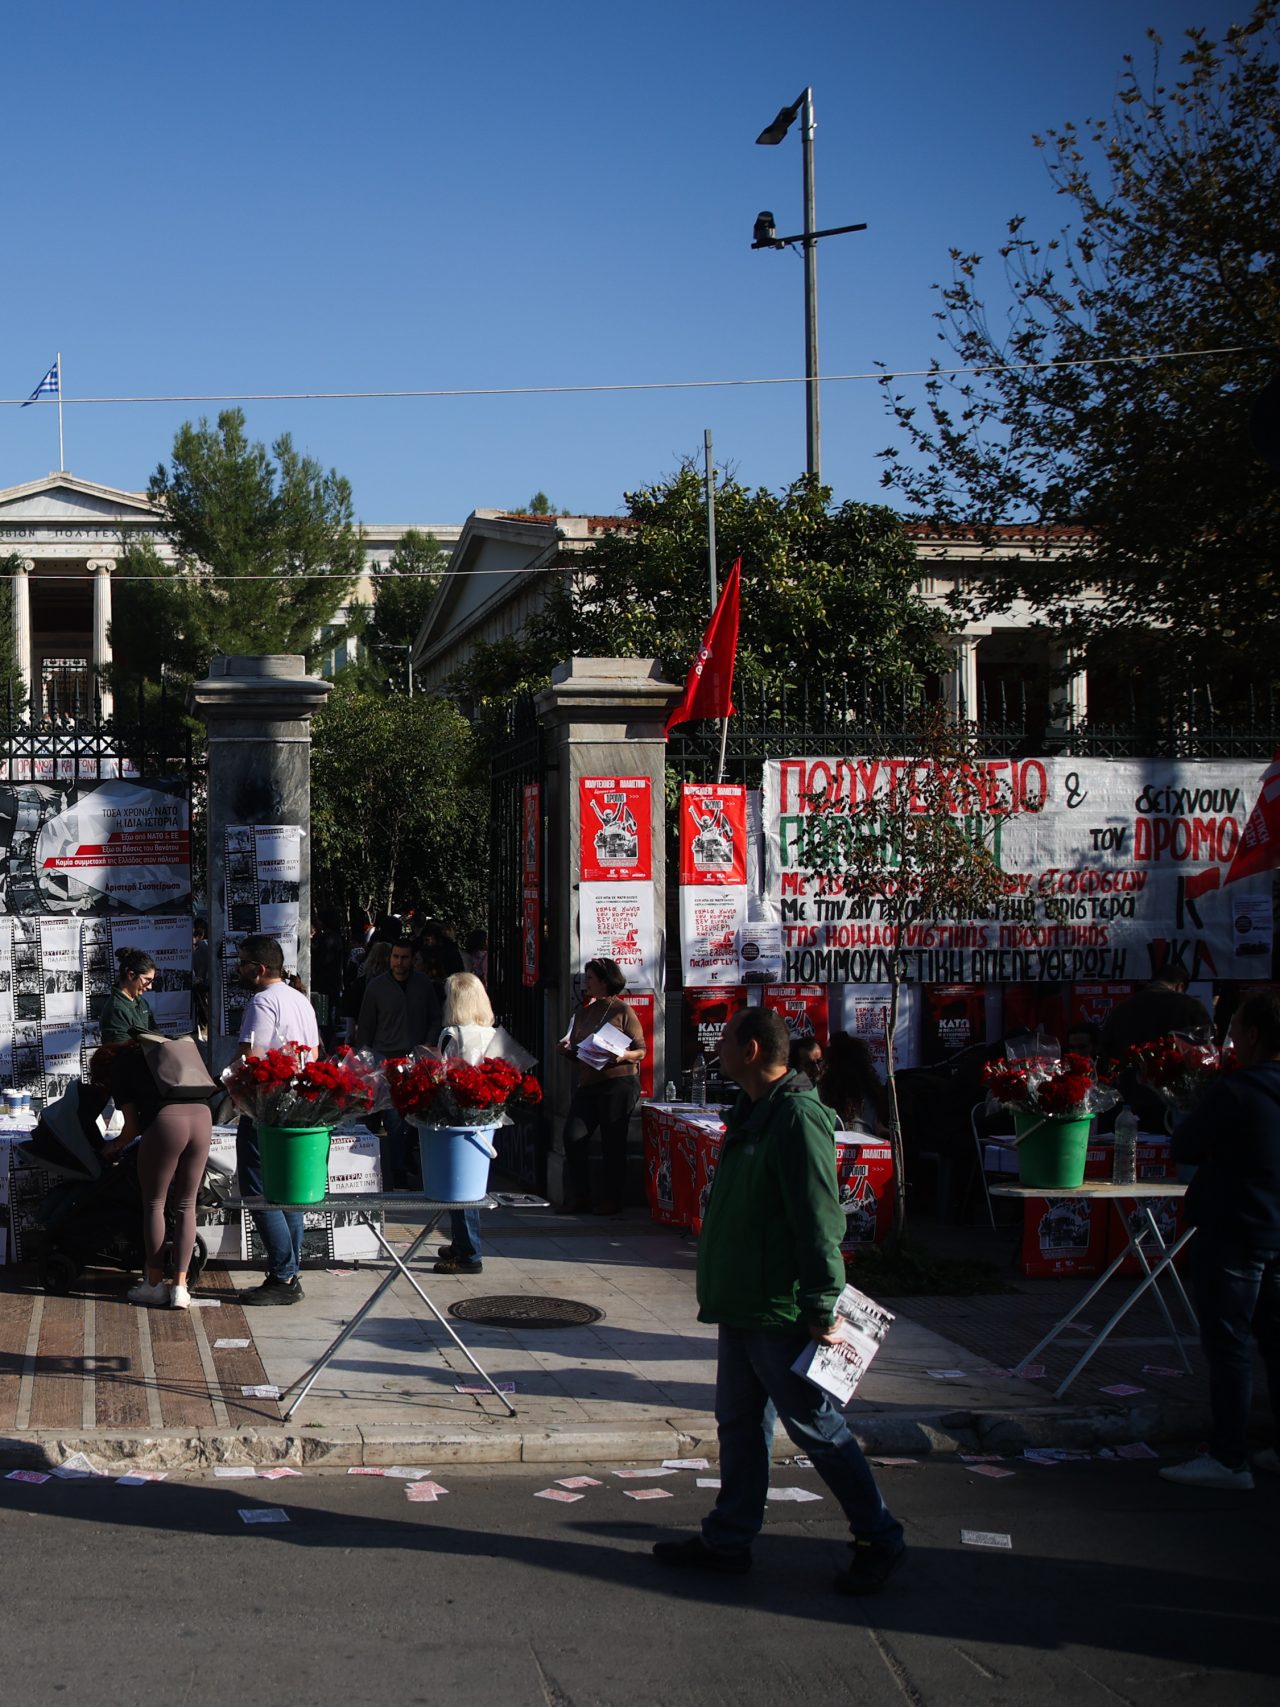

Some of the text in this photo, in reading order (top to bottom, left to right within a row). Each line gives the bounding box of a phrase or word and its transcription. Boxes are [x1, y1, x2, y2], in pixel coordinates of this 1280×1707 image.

[103, 806, 178, 818] ΤΟΣΑ ΧΡΟΝΙΑ ΝΑΤΟ
[124, 818, 143, 828] ΙΔΙΑ
[144, 817, 178, 827] ΙΣΤΟΡΙΑ
[147, 832, 163, 840] ΝΑΤΟ
[170, 831, 179, 839] ΕΕ
[1090, 817, 1239, 862] τον ΔΡΟΜΟ
[55, 858, 73, 867] Καμία
[781, 872, 807, 896] Με
[781, 899, 806, 921] Με
[783, 926, 818, 947] της
[786, 950, 964, 983] ΚΟΜΜΟΥΝΣΤΙΚΗ
[939, 1018, 970, 1028] ΚΑΤΩ
[336, 1181, 376, 1190] ΠΑΛΑΙΣΤΙΝΗ
